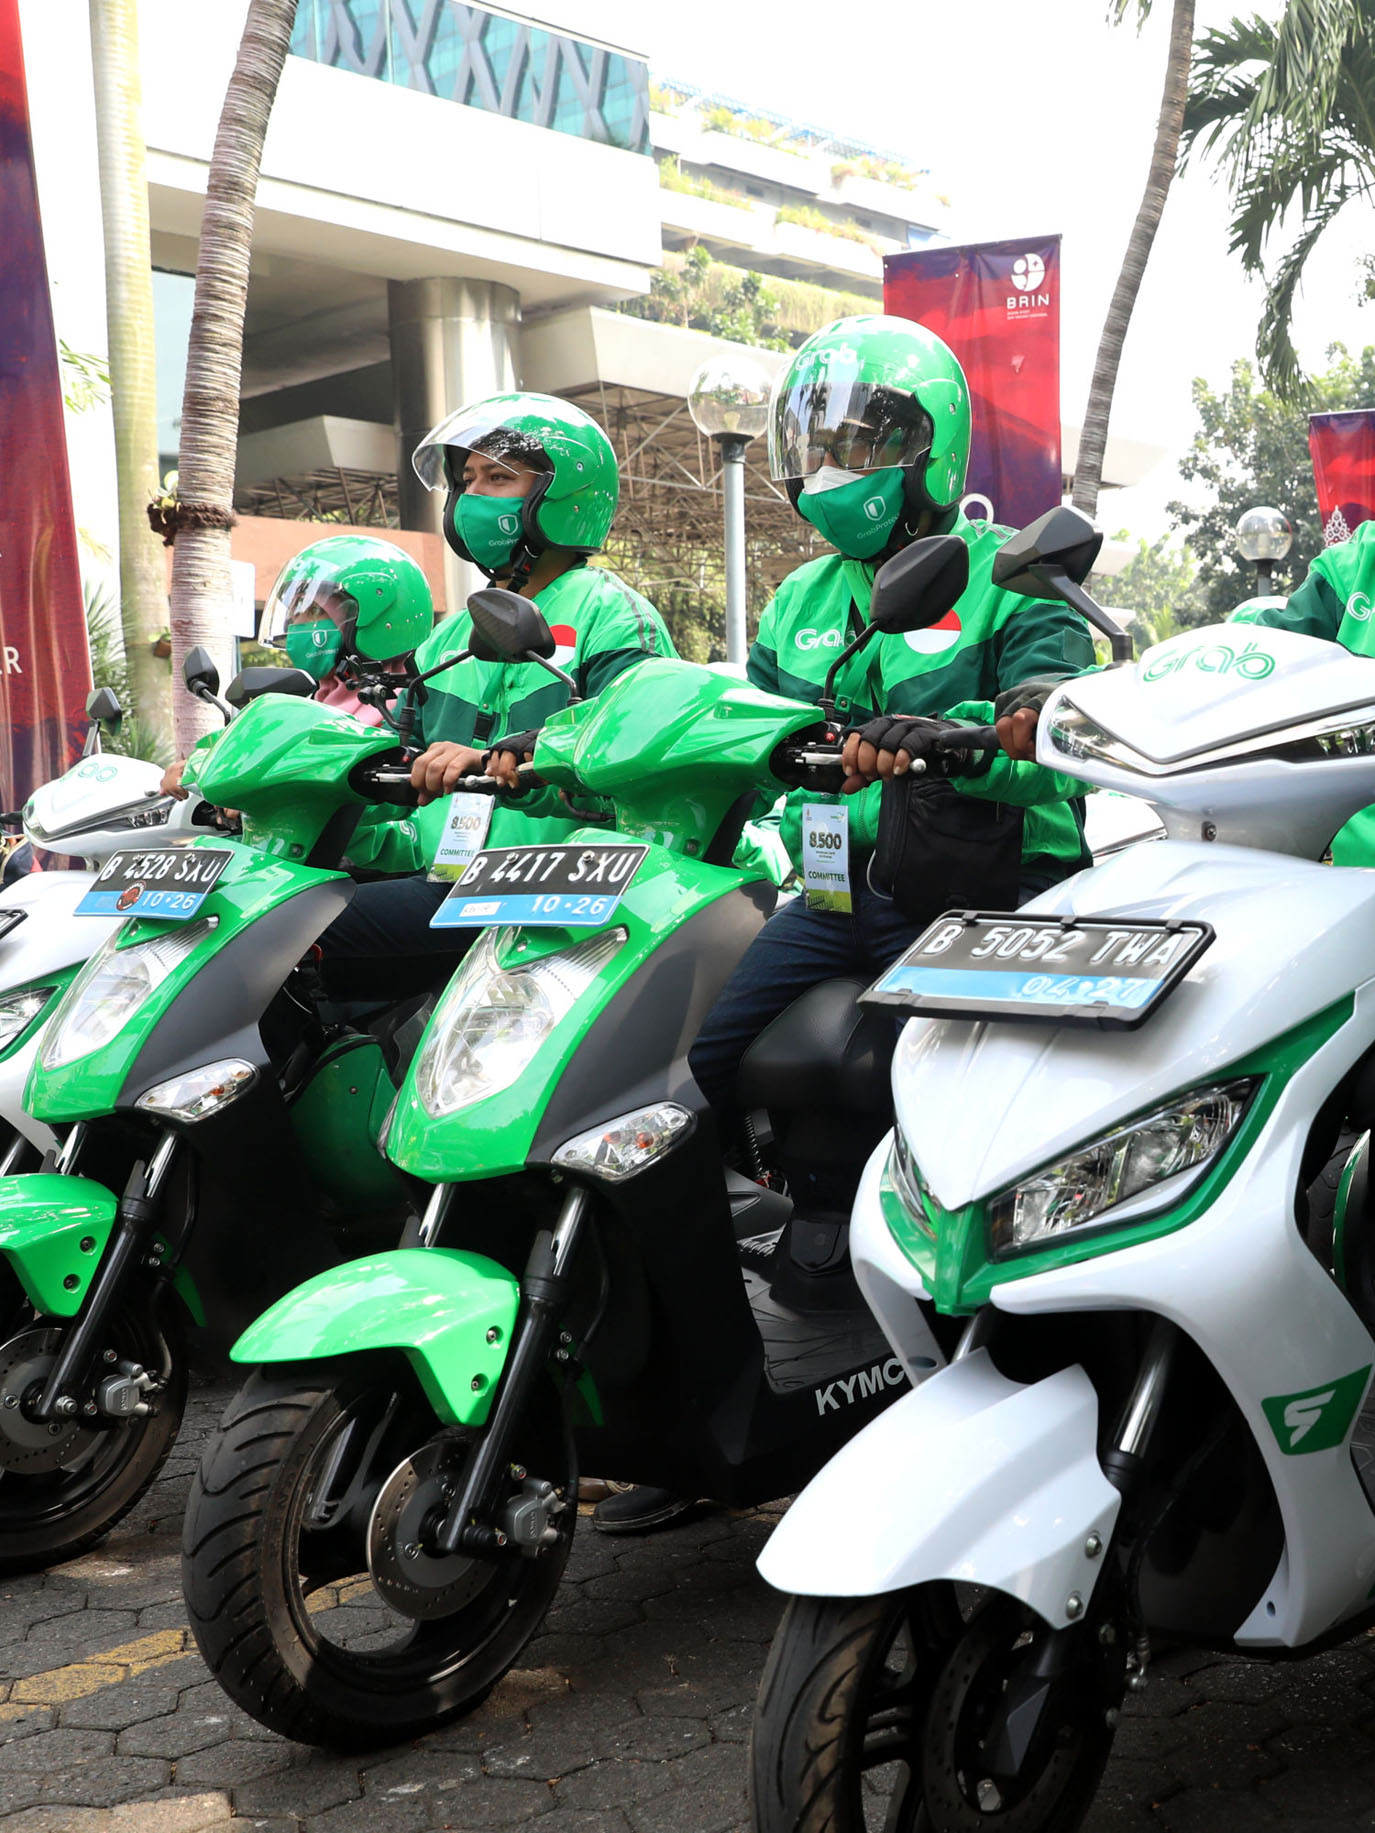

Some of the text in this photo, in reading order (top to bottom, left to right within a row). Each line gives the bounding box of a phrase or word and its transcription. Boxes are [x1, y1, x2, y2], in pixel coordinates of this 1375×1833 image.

[1007, 293, 1049, 309] BRIN
[1143, 642, 1275, 682] Grab
[809, 831, 842, 850] 8.500
[100, 855, 123, 882] B
[123, 853, 176, 880] 4528
[460, 850, 638, 885] B 4417 SXU
[808, 870, 846, 882] COMMITTEE
[921, 925, 1186, 966] B 5052 TWA
[815, 1357, 905, 1416] KYMC
